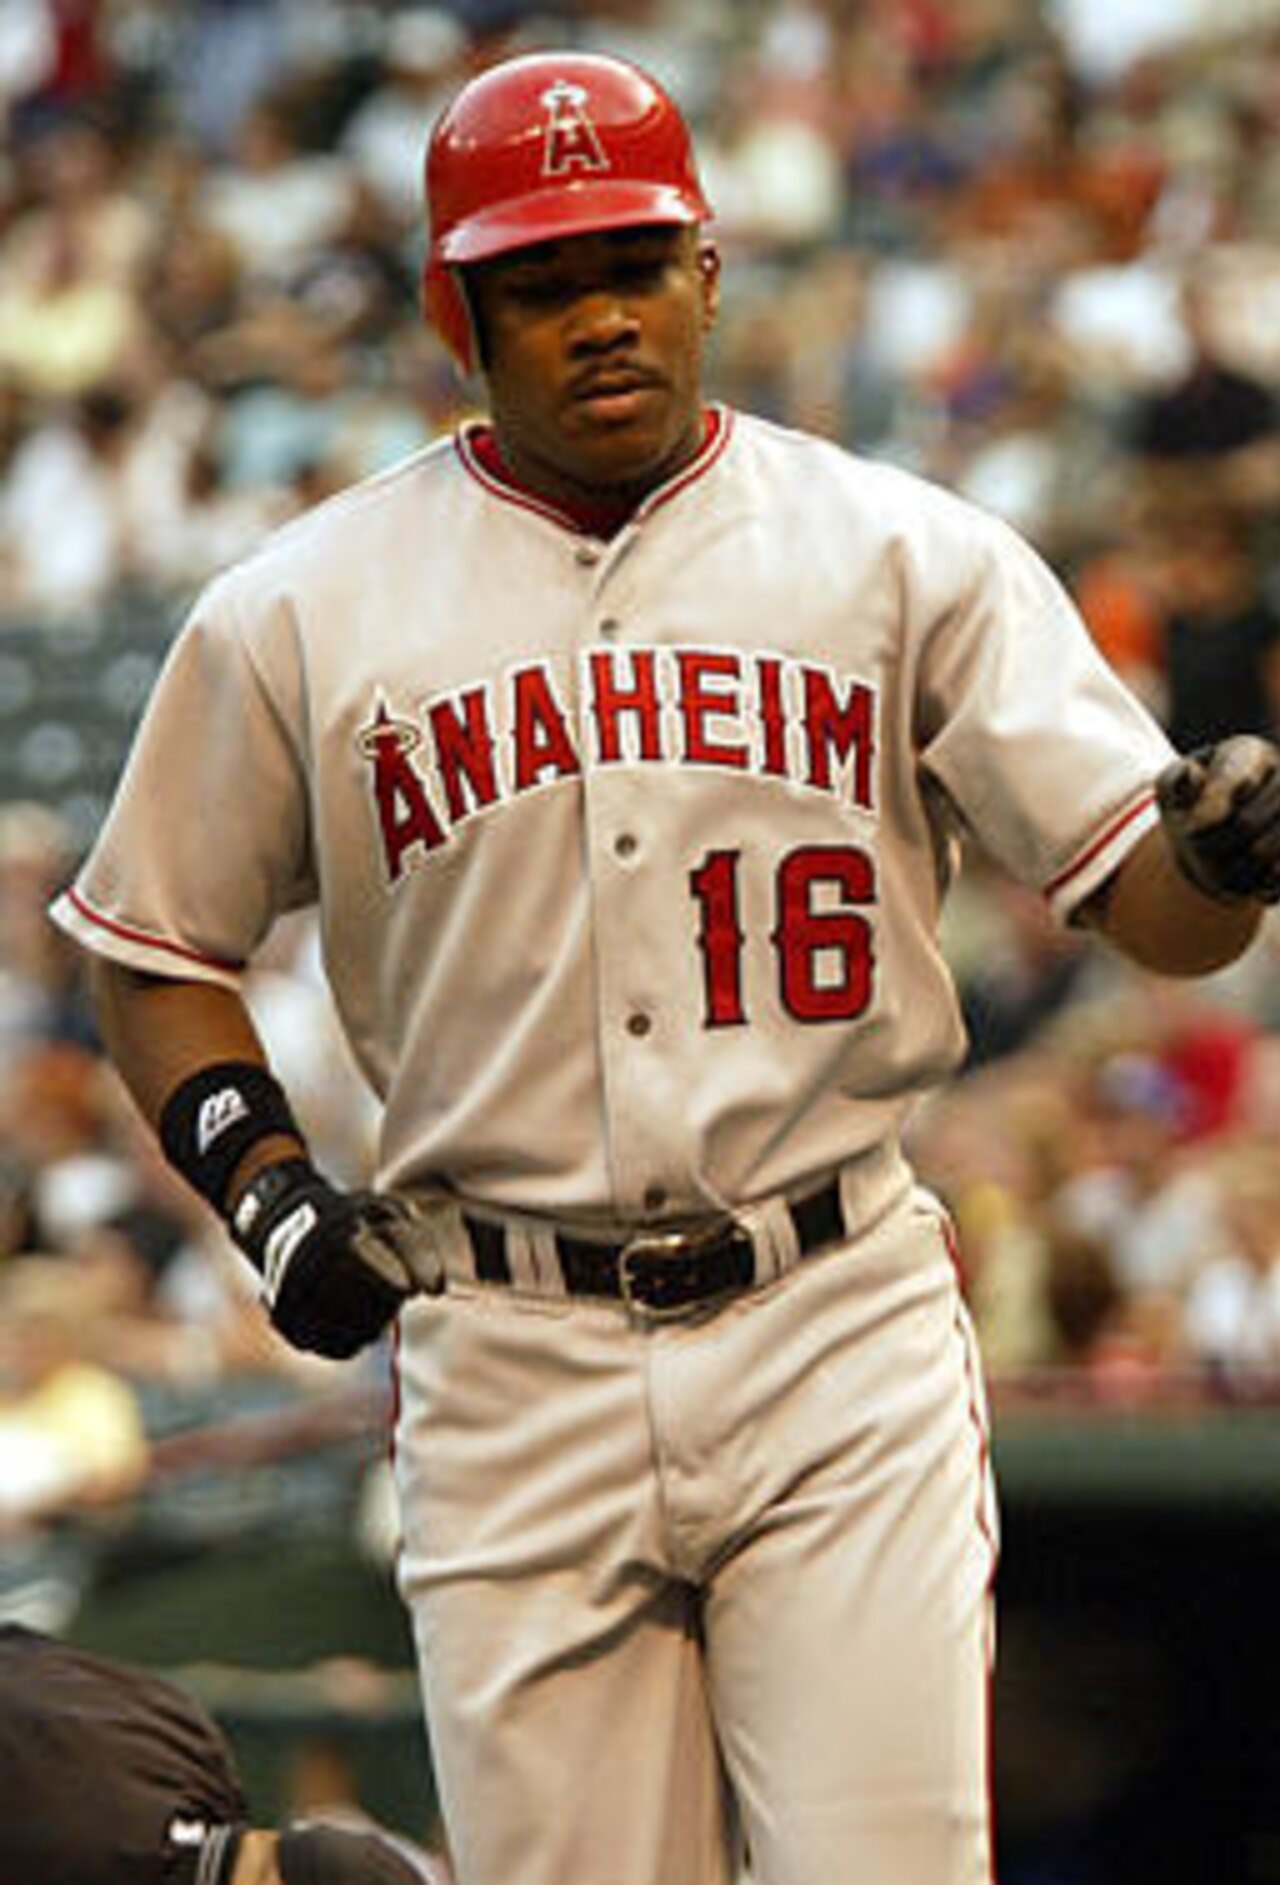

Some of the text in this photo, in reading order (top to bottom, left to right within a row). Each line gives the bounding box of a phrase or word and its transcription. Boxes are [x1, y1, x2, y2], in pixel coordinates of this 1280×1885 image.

[541, 79, 611, 175] A
[360, 645, 880, 886] ANAHEIM
[689, 845, 877, 1030] 16
